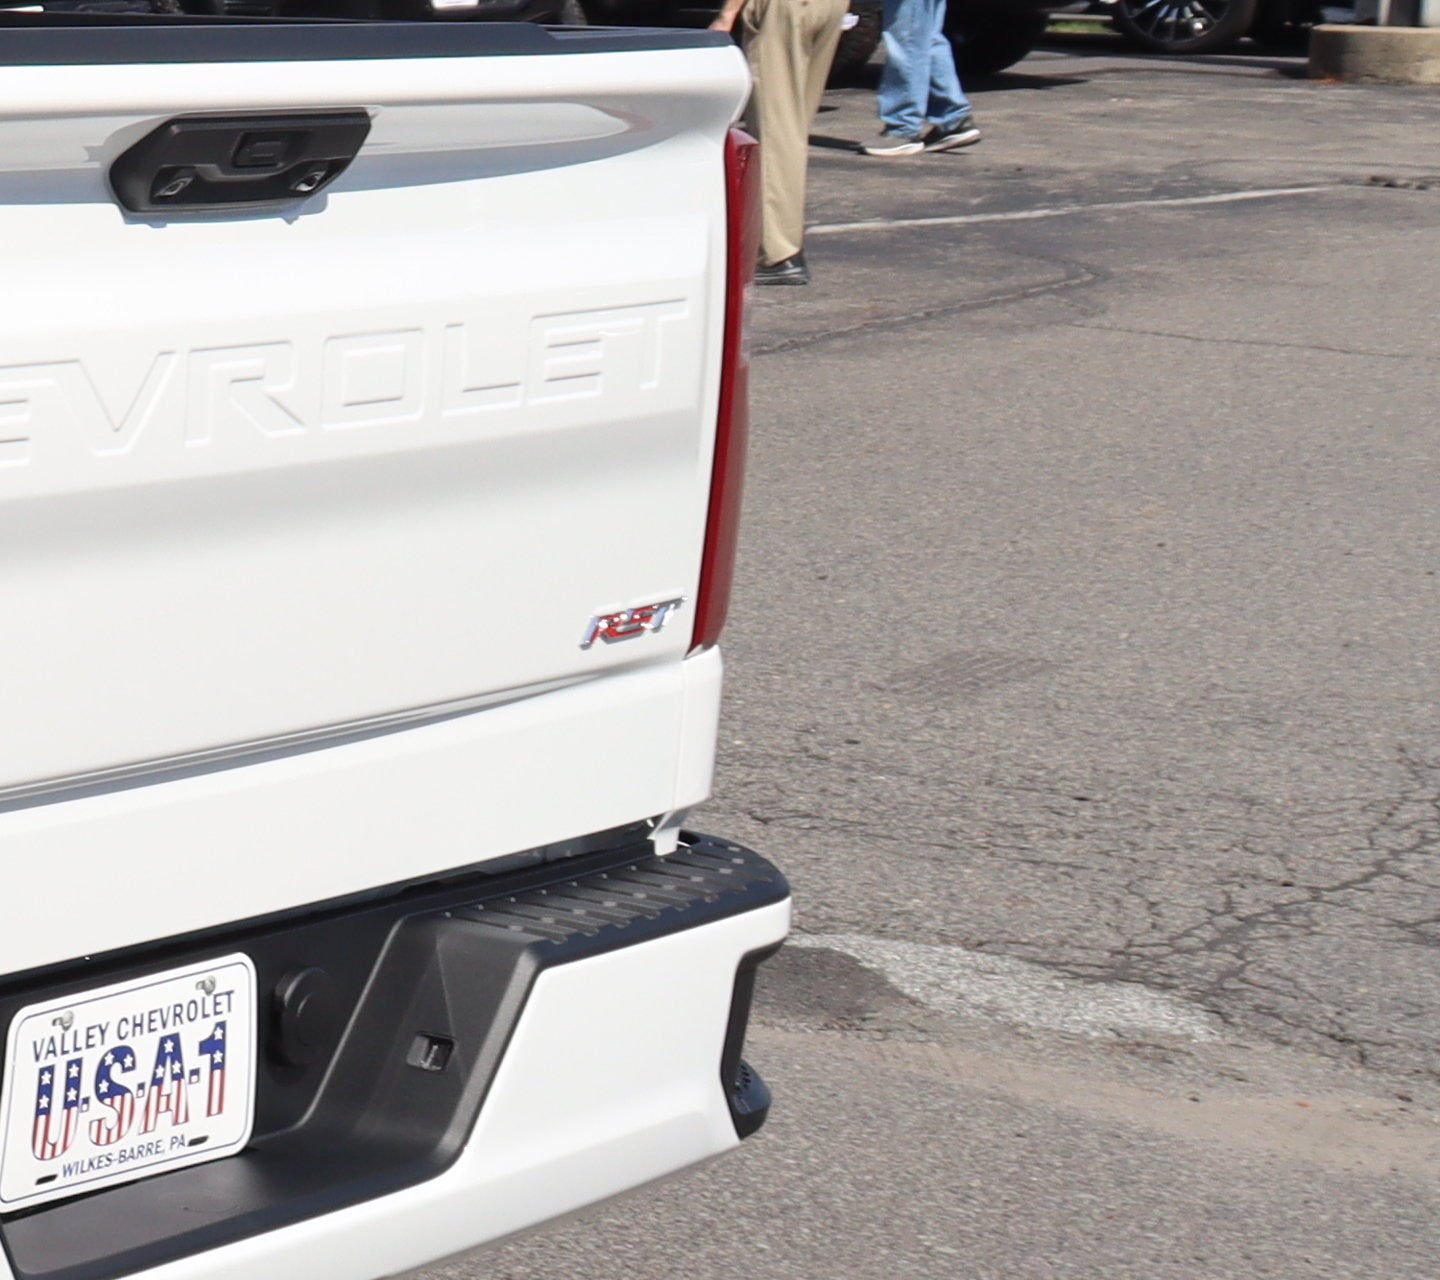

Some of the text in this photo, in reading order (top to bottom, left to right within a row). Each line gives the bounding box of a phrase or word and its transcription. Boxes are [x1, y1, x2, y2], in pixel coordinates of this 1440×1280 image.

[579, 596, 687, 650] RST
[32, 989, 235, 1063] VALLEY CHEVROLET
[168, 1134, 187, 1152] PA
